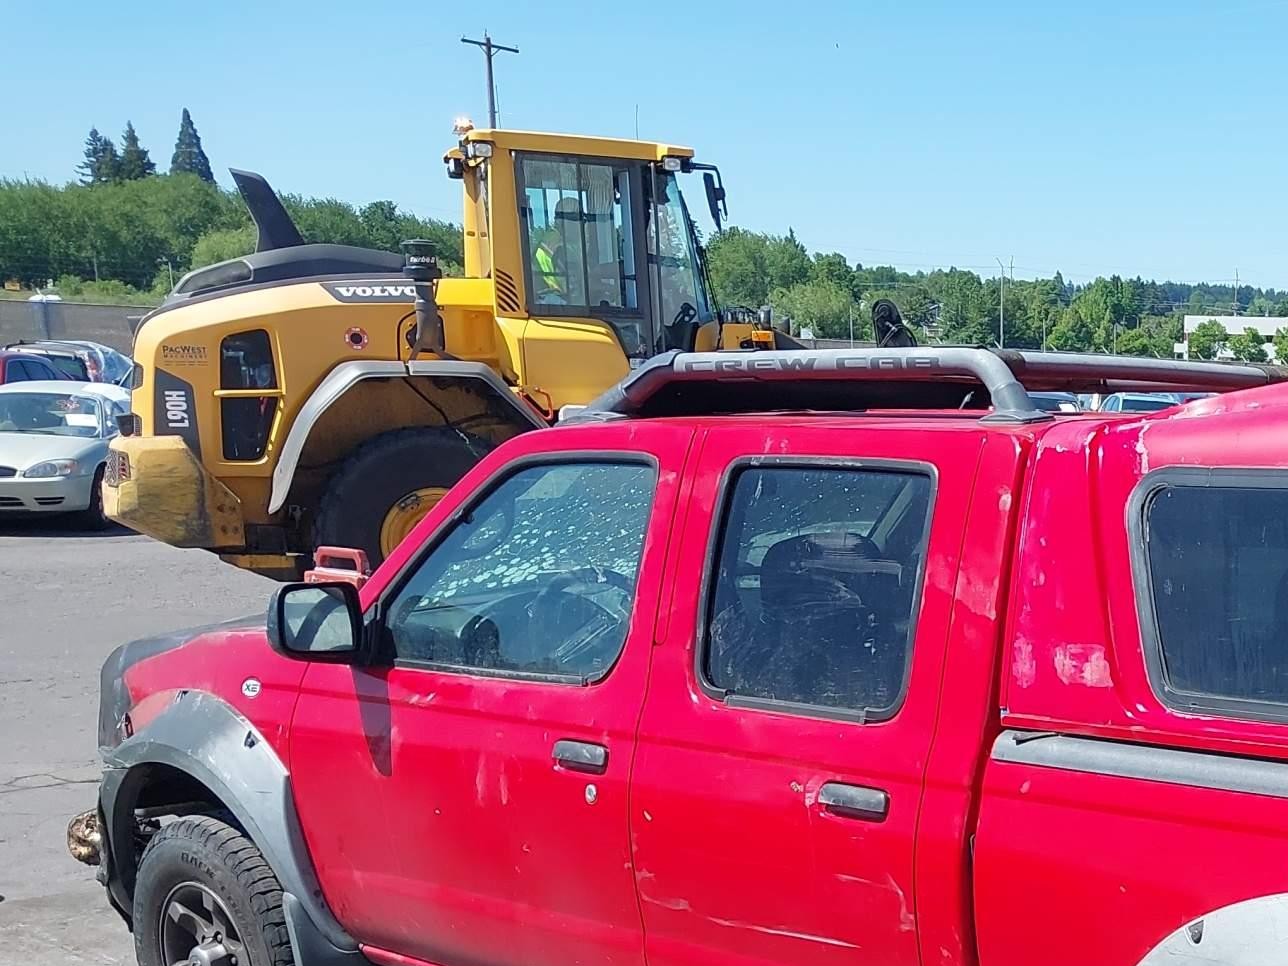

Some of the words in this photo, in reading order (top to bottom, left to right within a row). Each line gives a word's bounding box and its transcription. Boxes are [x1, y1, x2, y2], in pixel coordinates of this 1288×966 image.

[684, 357, 817, 373] CREW
[835, 356, 942, 370] CAB
[164, 390, 190, 428] L90H
[244, 682, 258, 693] XE
